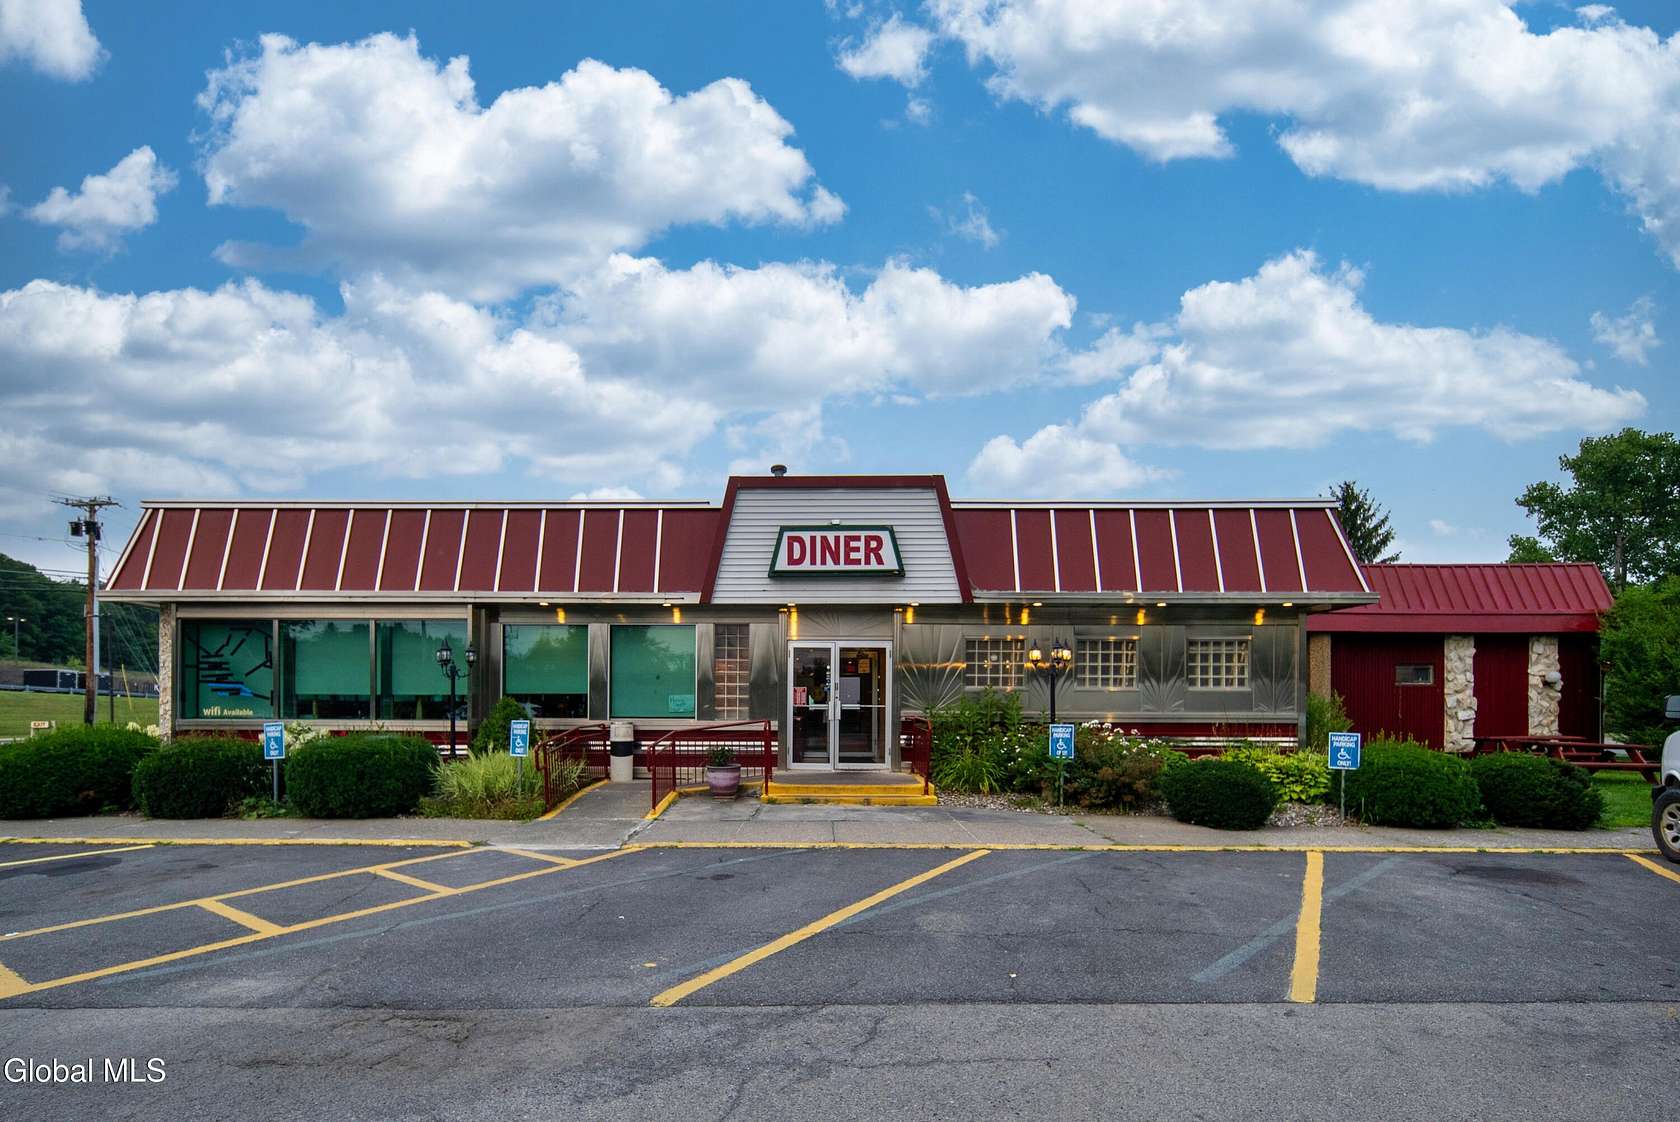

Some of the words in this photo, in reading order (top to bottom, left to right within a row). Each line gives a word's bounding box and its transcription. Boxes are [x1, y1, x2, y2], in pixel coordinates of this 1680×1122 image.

[787, 535, 885, 566] DINER
[203, 706, 221, 716] wifi
[223, 708, 254, 716] Available
